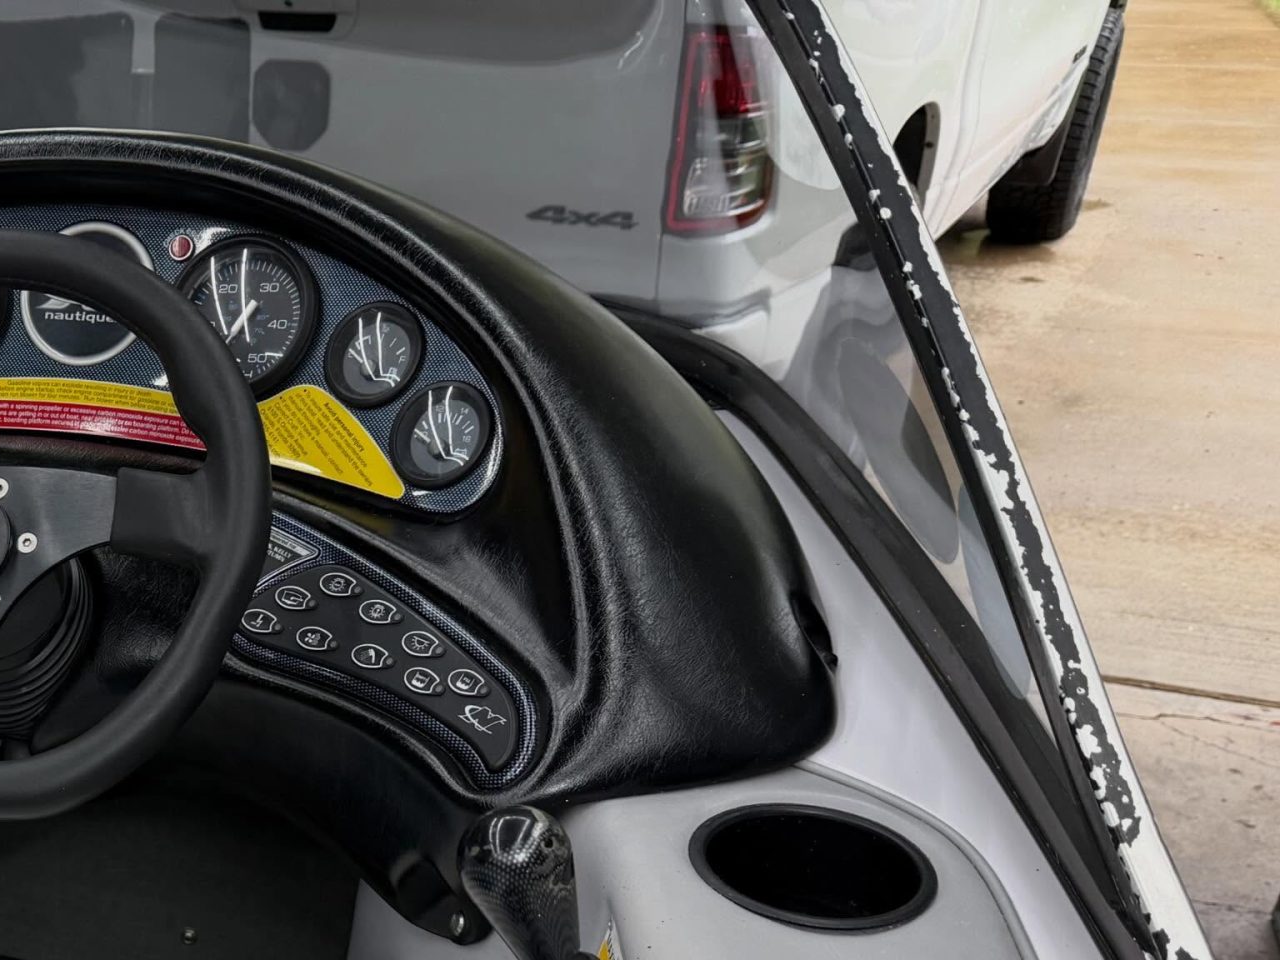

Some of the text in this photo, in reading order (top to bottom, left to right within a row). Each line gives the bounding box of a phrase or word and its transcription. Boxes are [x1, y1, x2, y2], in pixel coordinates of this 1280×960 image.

[219, 284, 238, 293] 20
[260, 283, 279, 292] 30
[45, 311, 117, 324] nautique
[268, 320, 287, 329] 40
[248, 353, 267, 363] 50
